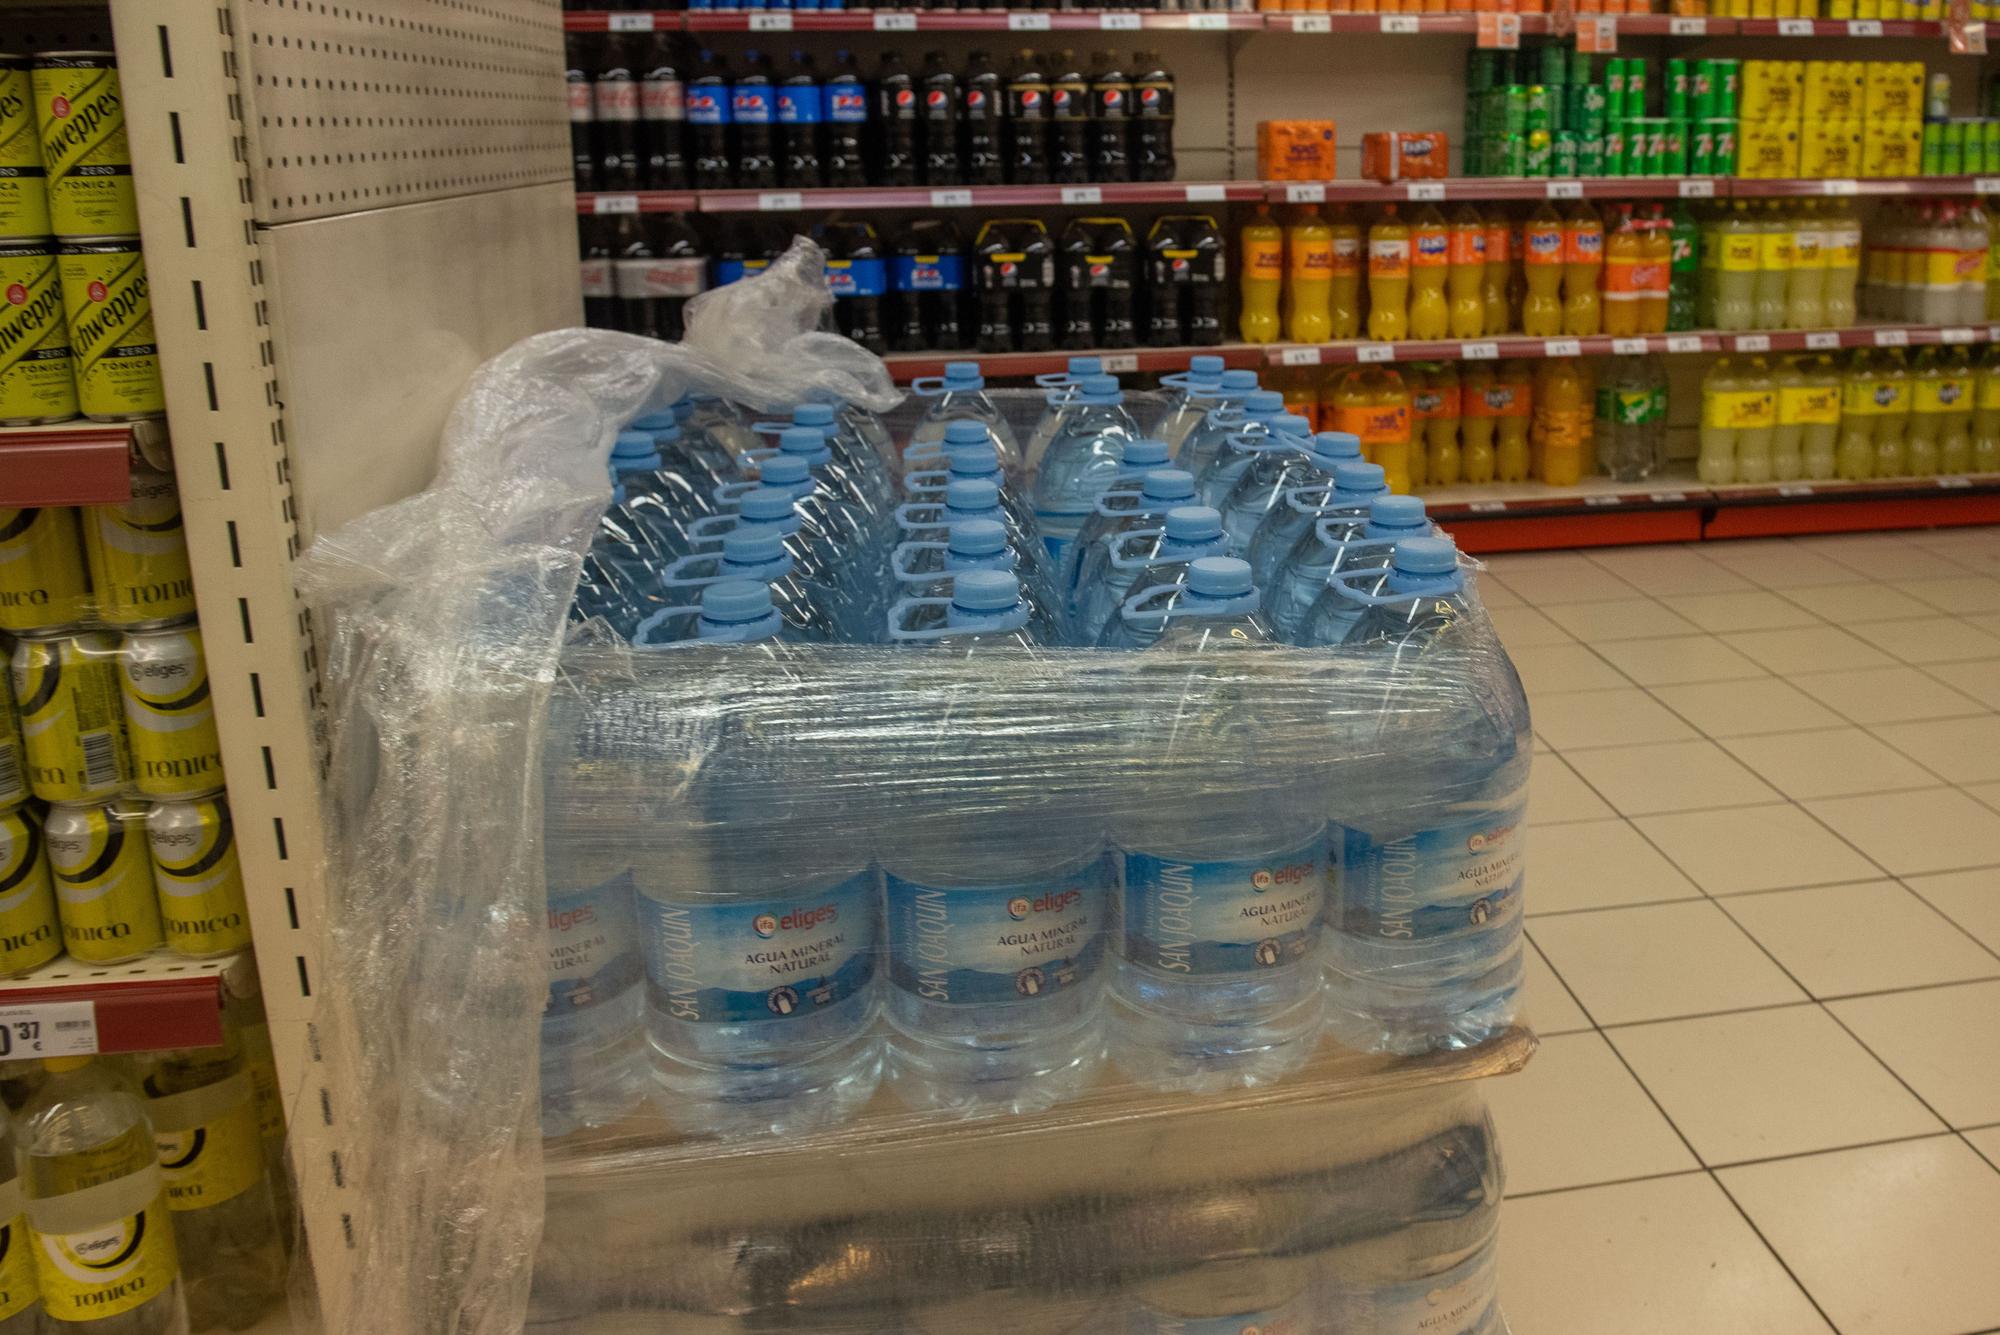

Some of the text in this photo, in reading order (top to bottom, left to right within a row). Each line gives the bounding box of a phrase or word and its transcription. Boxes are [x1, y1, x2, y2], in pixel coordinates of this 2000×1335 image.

[44, 91, 120, 171] hweppes
[80, 166, 116, 176] ZERO
[118, 346, 153, 356] ZERO
[145, 663, 186, 679] eliges
[1379, 835, 1423, 938] SAN JOAQUIN
[1457, 865, 1489, 881] AGUA
[1032, 888, 1081, 913] eliges
[1239, 904, 1278, 918] AGUA
[549, 903, 594, 932] liges
[780, 902, 838, 931] eliges
[1158, 861, 1200, 972] SAN JOAQUIN
[659, 904, 702, 985] JOAQUIN
[915, 887, 955, 1001] SAN JOAQUIN
[996, 916, 1087, 946] AGUA MINERAL
[744, 931, 844, 965] AGUA MINERAL
[1020, 935, 1076, 955] NATURAL
[553, 954, 593, 970] URAL
[769, 952, 831, 974] NATURAL
[667, 984, 700, 1021] SAN
[32, 1041, 43, 1052] €
